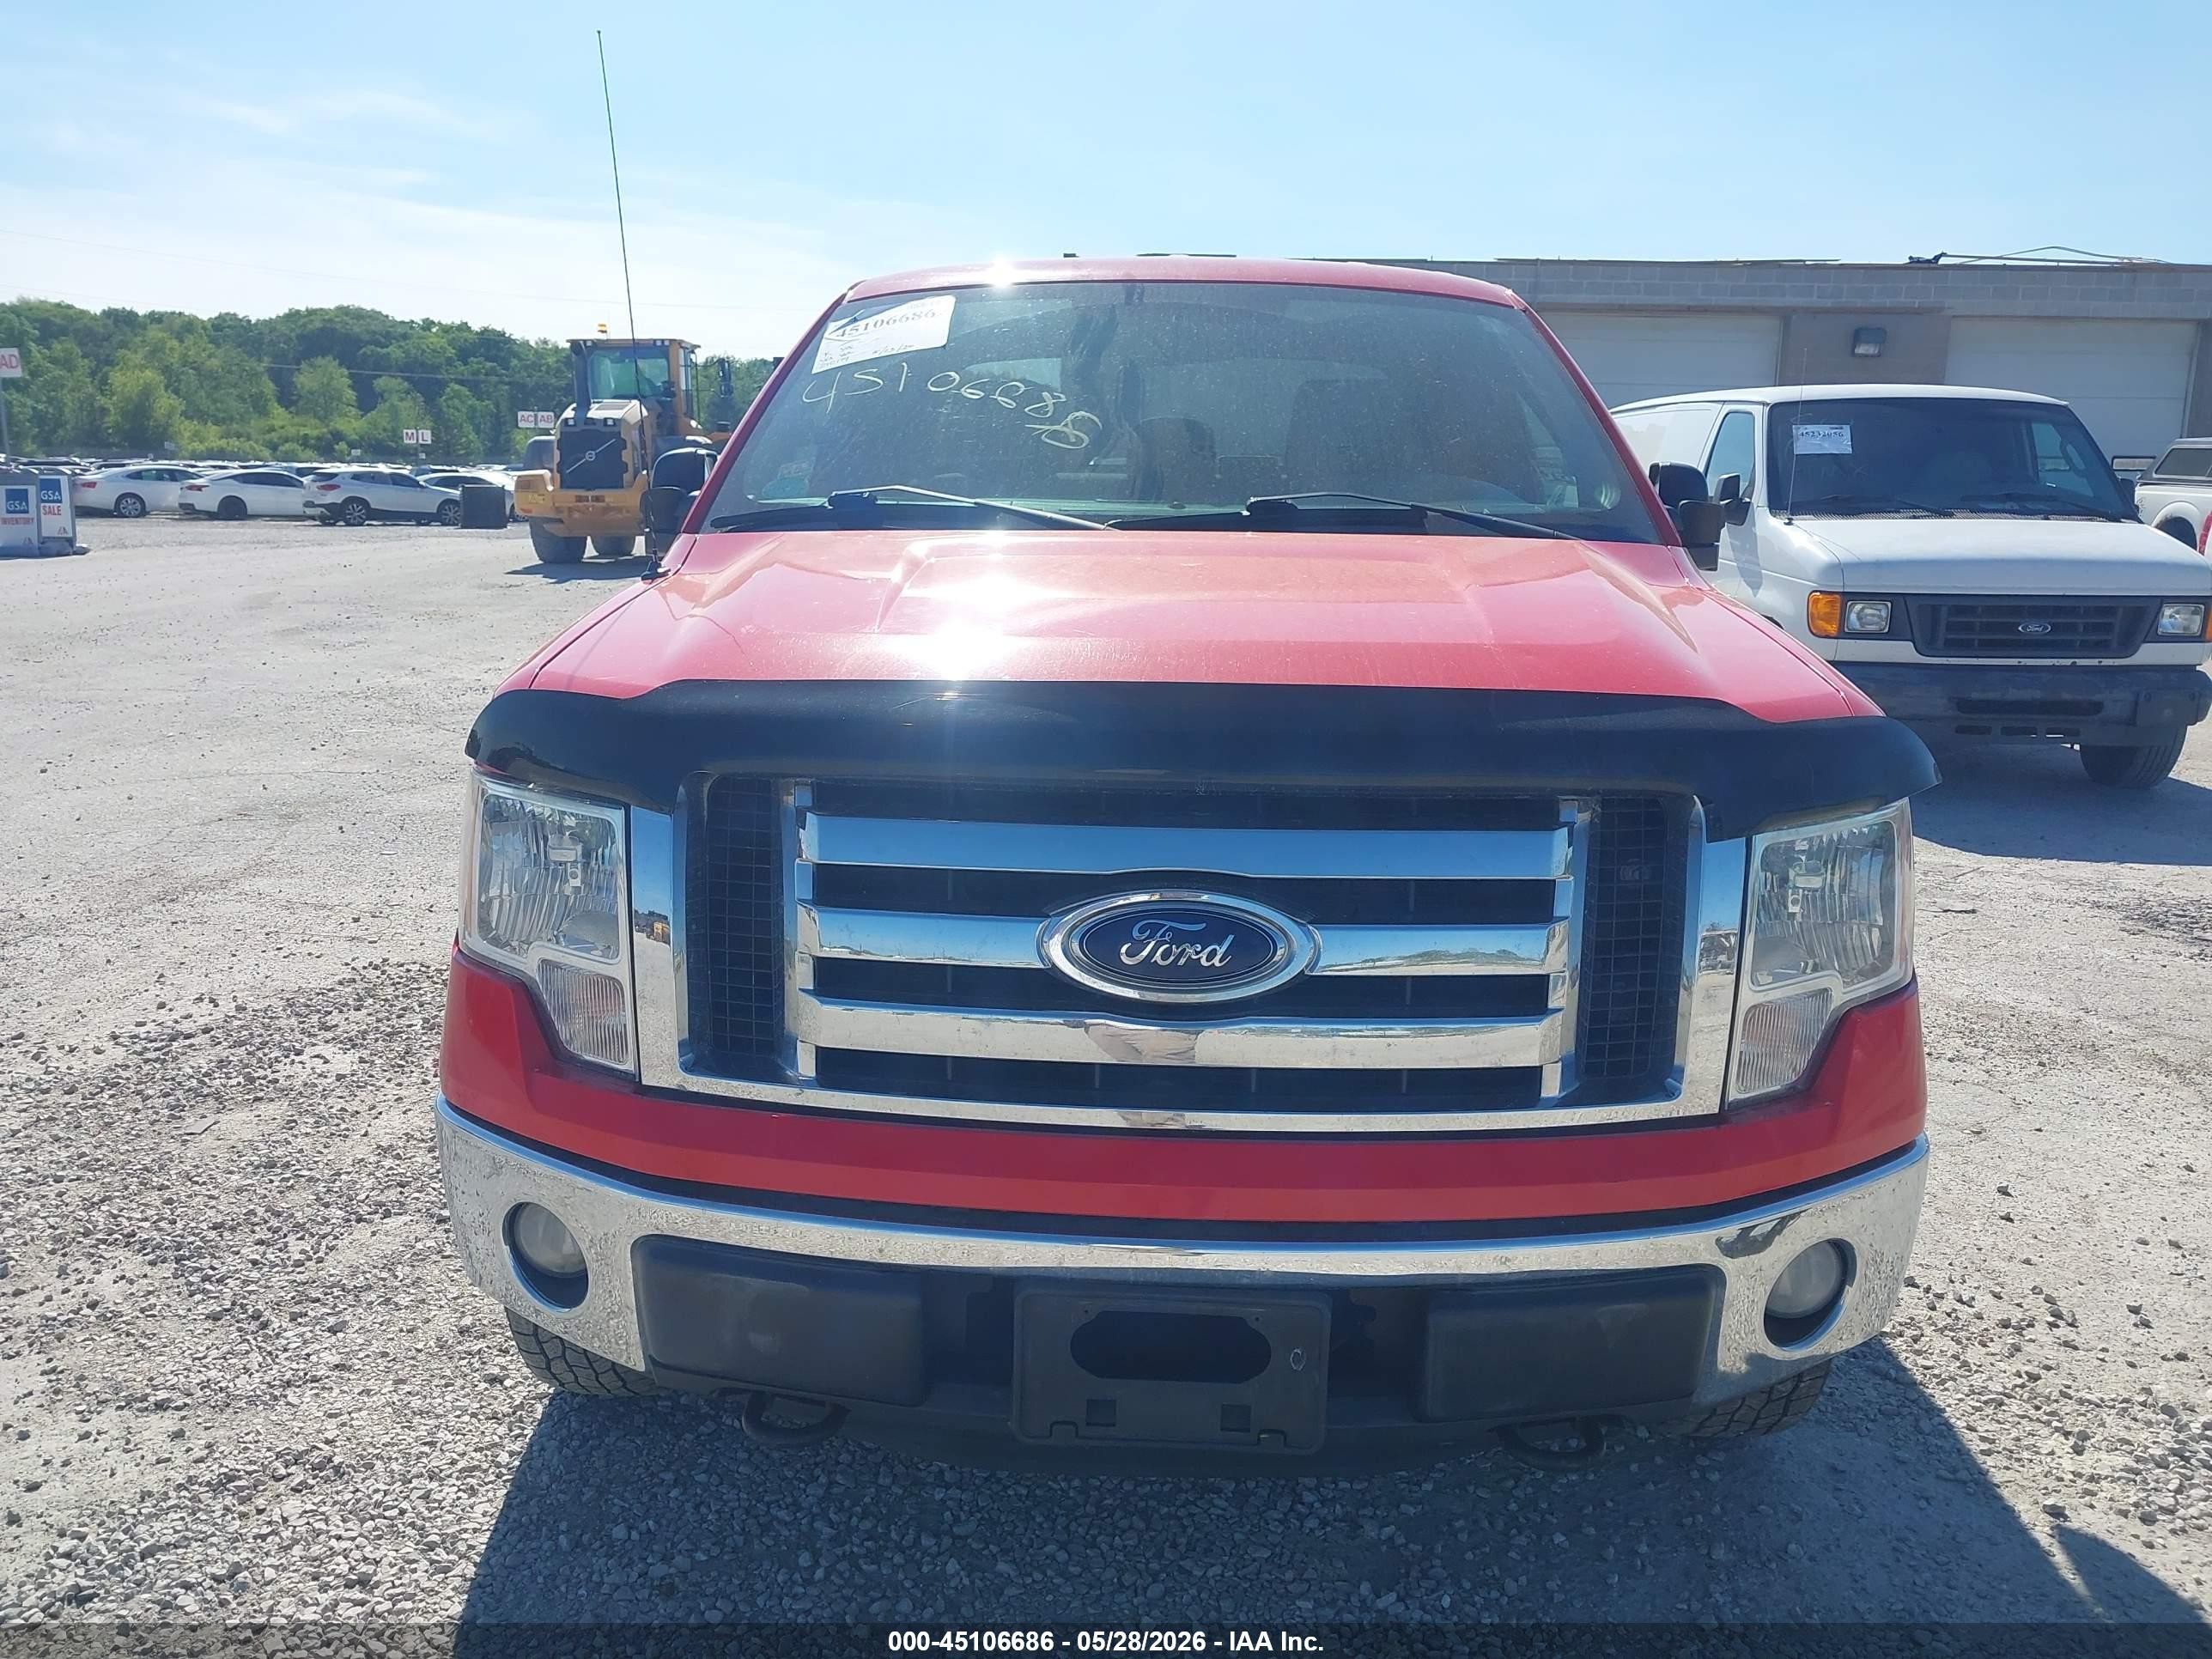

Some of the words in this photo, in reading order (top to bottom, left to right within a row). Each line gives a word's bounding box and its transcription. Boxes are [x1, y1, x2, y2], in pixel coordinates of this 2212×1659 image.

[836, 309, 936, 337] 45106686
[520, 415, 534, 423] AC
[539, 415, 554, 423] AB
[405, 431, 415, 441] M
[421, 433, 428, 441] L
[40, 490, 61, 500] GSA
[7, 501, 27, 510] GSA
[41, 505, 62, 515] SALE
[1119, 918, 1235, 968] Ford
